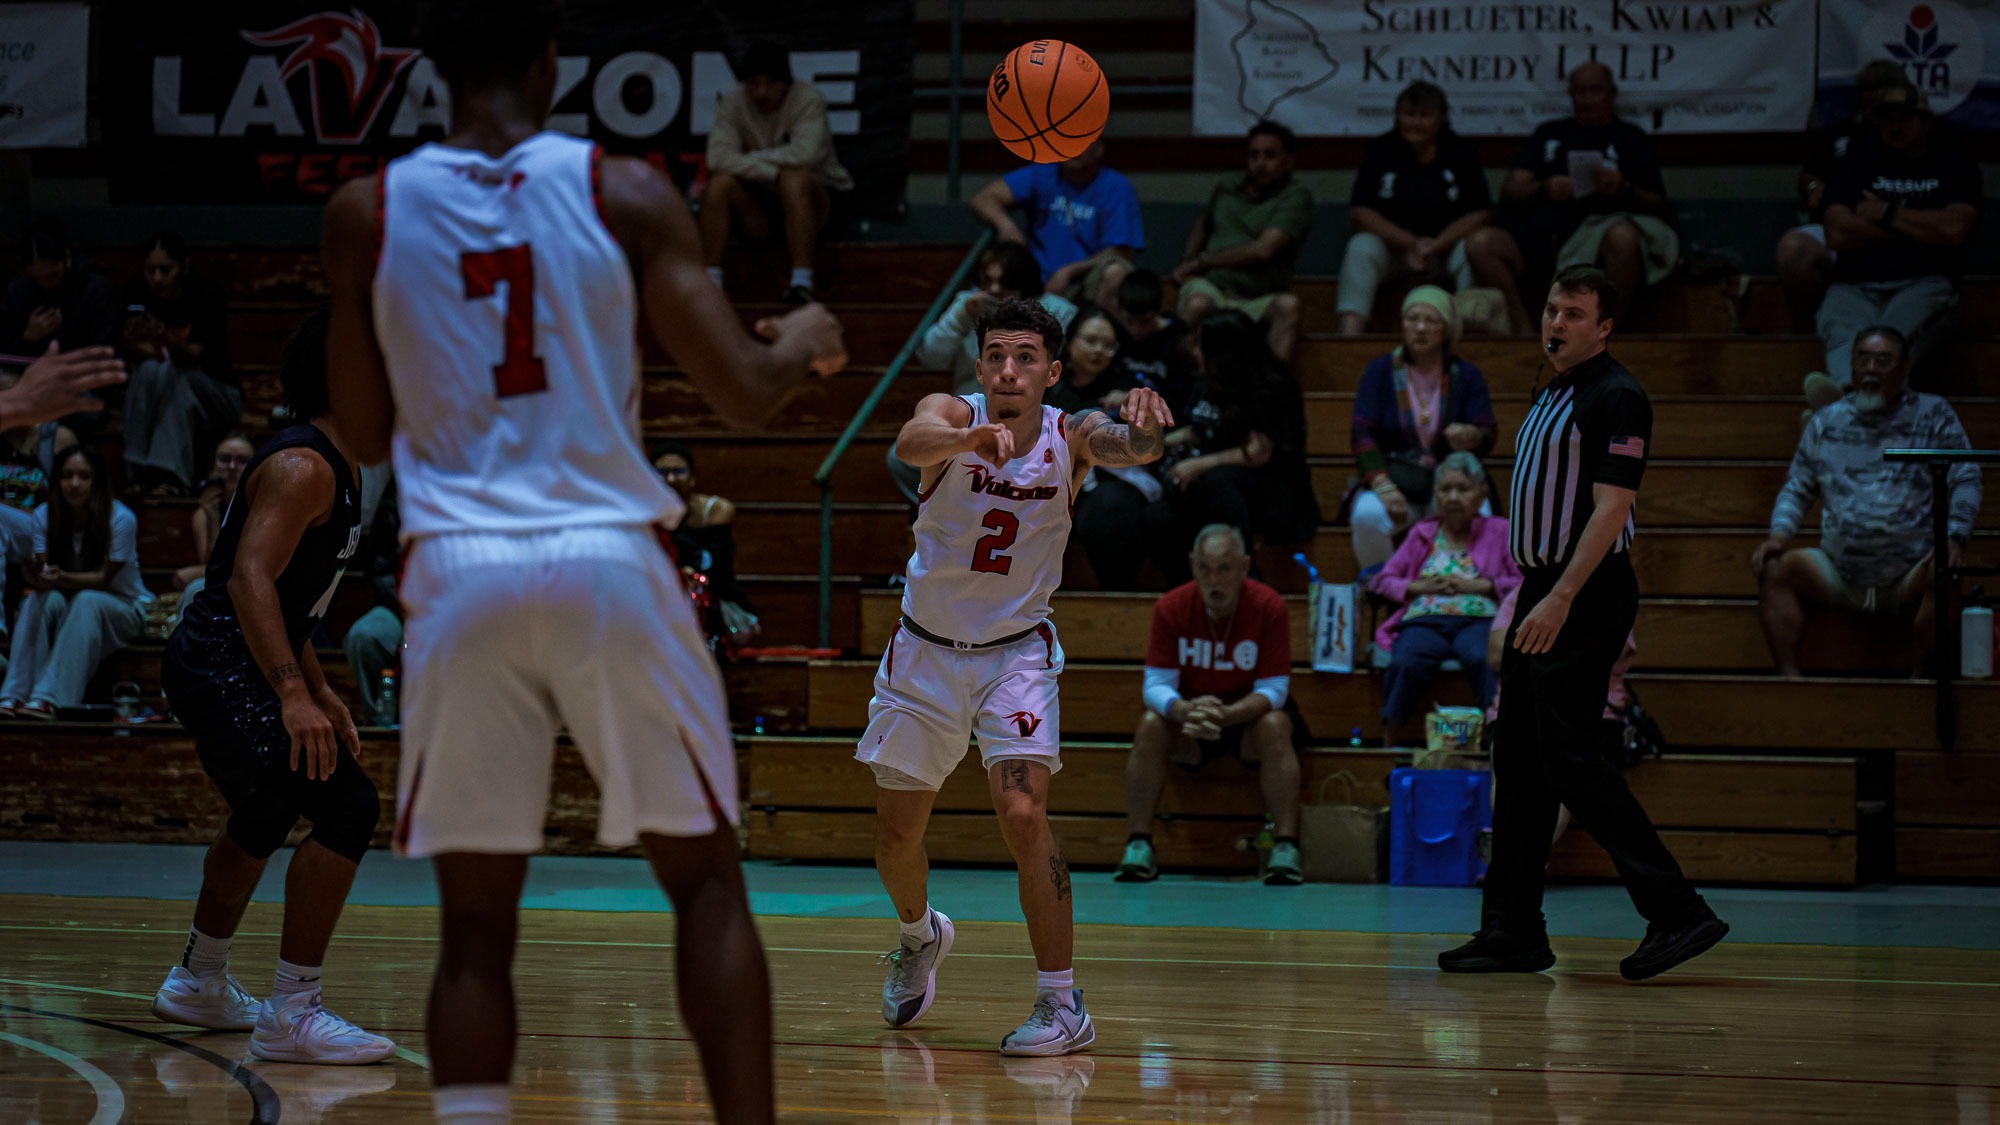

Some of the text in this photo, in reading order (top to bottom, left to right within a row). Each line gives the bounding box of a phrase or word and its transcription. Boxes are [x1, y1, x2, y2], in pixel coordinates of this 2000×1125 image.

[1611, 0, 1739, 31] KWIAT
[1754, 4, 1776, 28] &
[1363, 44, 1542, 82] KENNEDY
[1902, 62, 1951, 89] TA
[151, 45, 453, 147] LAVA
[256, 151, 385, 195] FEE
[461, 244, 548, 398] 7
[965, 468, 1059, 502] Vulcans
[971, 508, 1020, 576] 2
[1177, 636, 1260, 672] HILO
